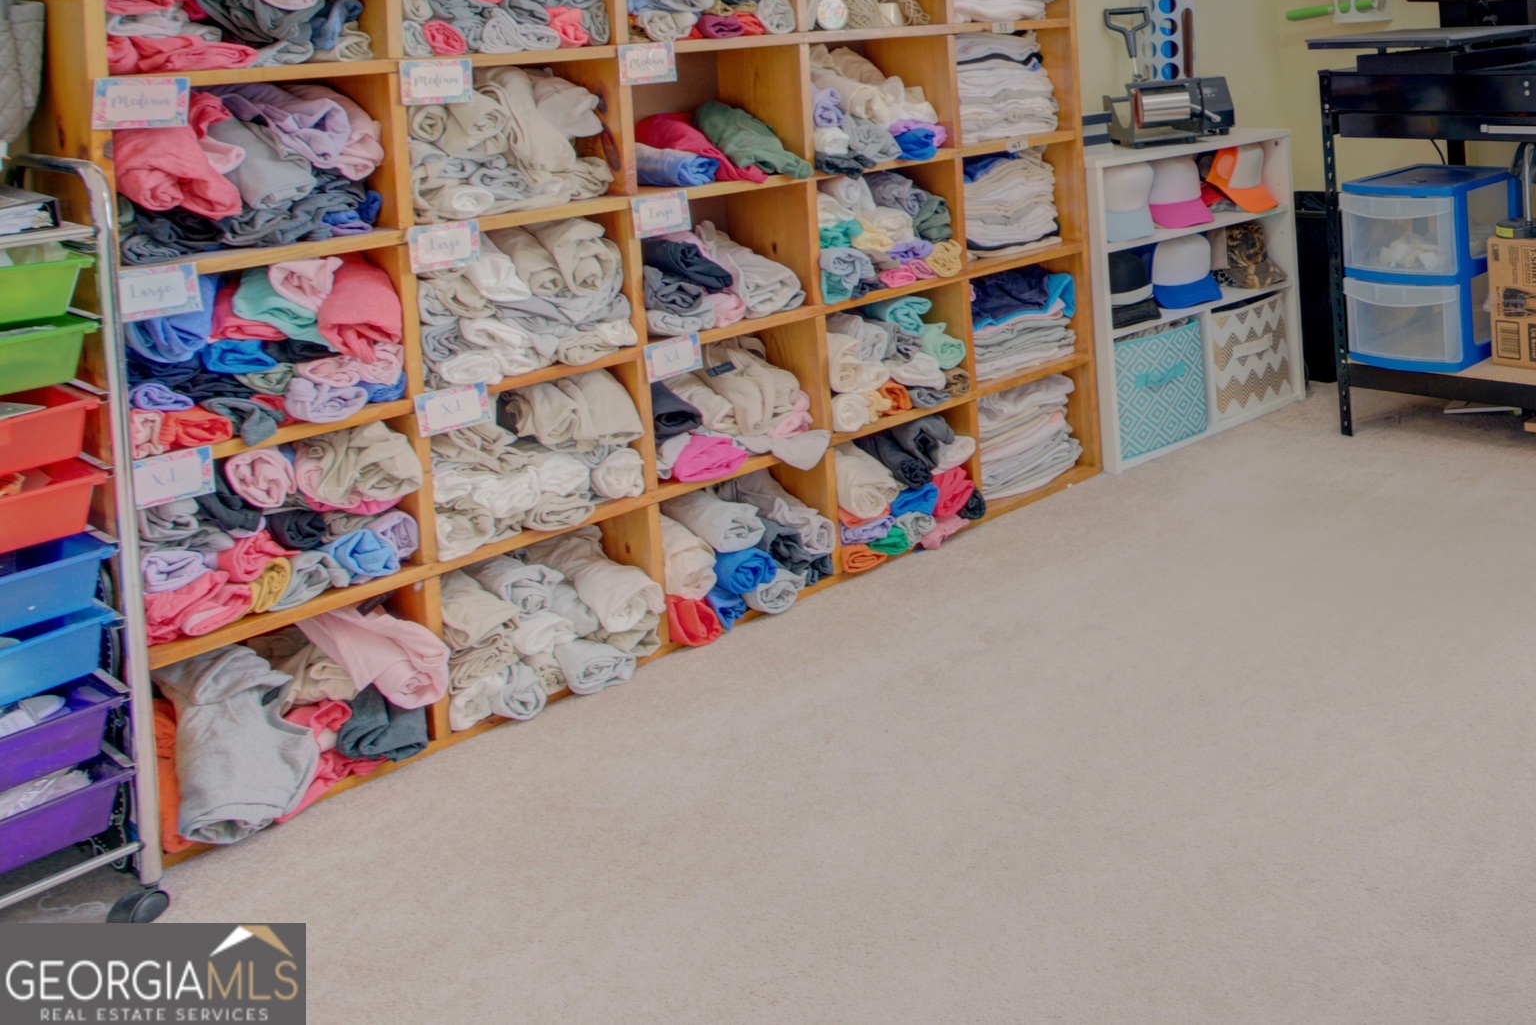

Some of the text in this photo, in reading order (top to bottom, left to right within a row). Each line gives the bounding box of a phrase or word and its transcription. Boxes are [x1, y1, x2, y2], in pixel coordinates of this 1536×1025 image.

[414, 73, 459, 87] Medium
[111, 92, 171, 109] Medium
[430, 237, 462, 255] Large
[129, 283, 174, 303] Large
